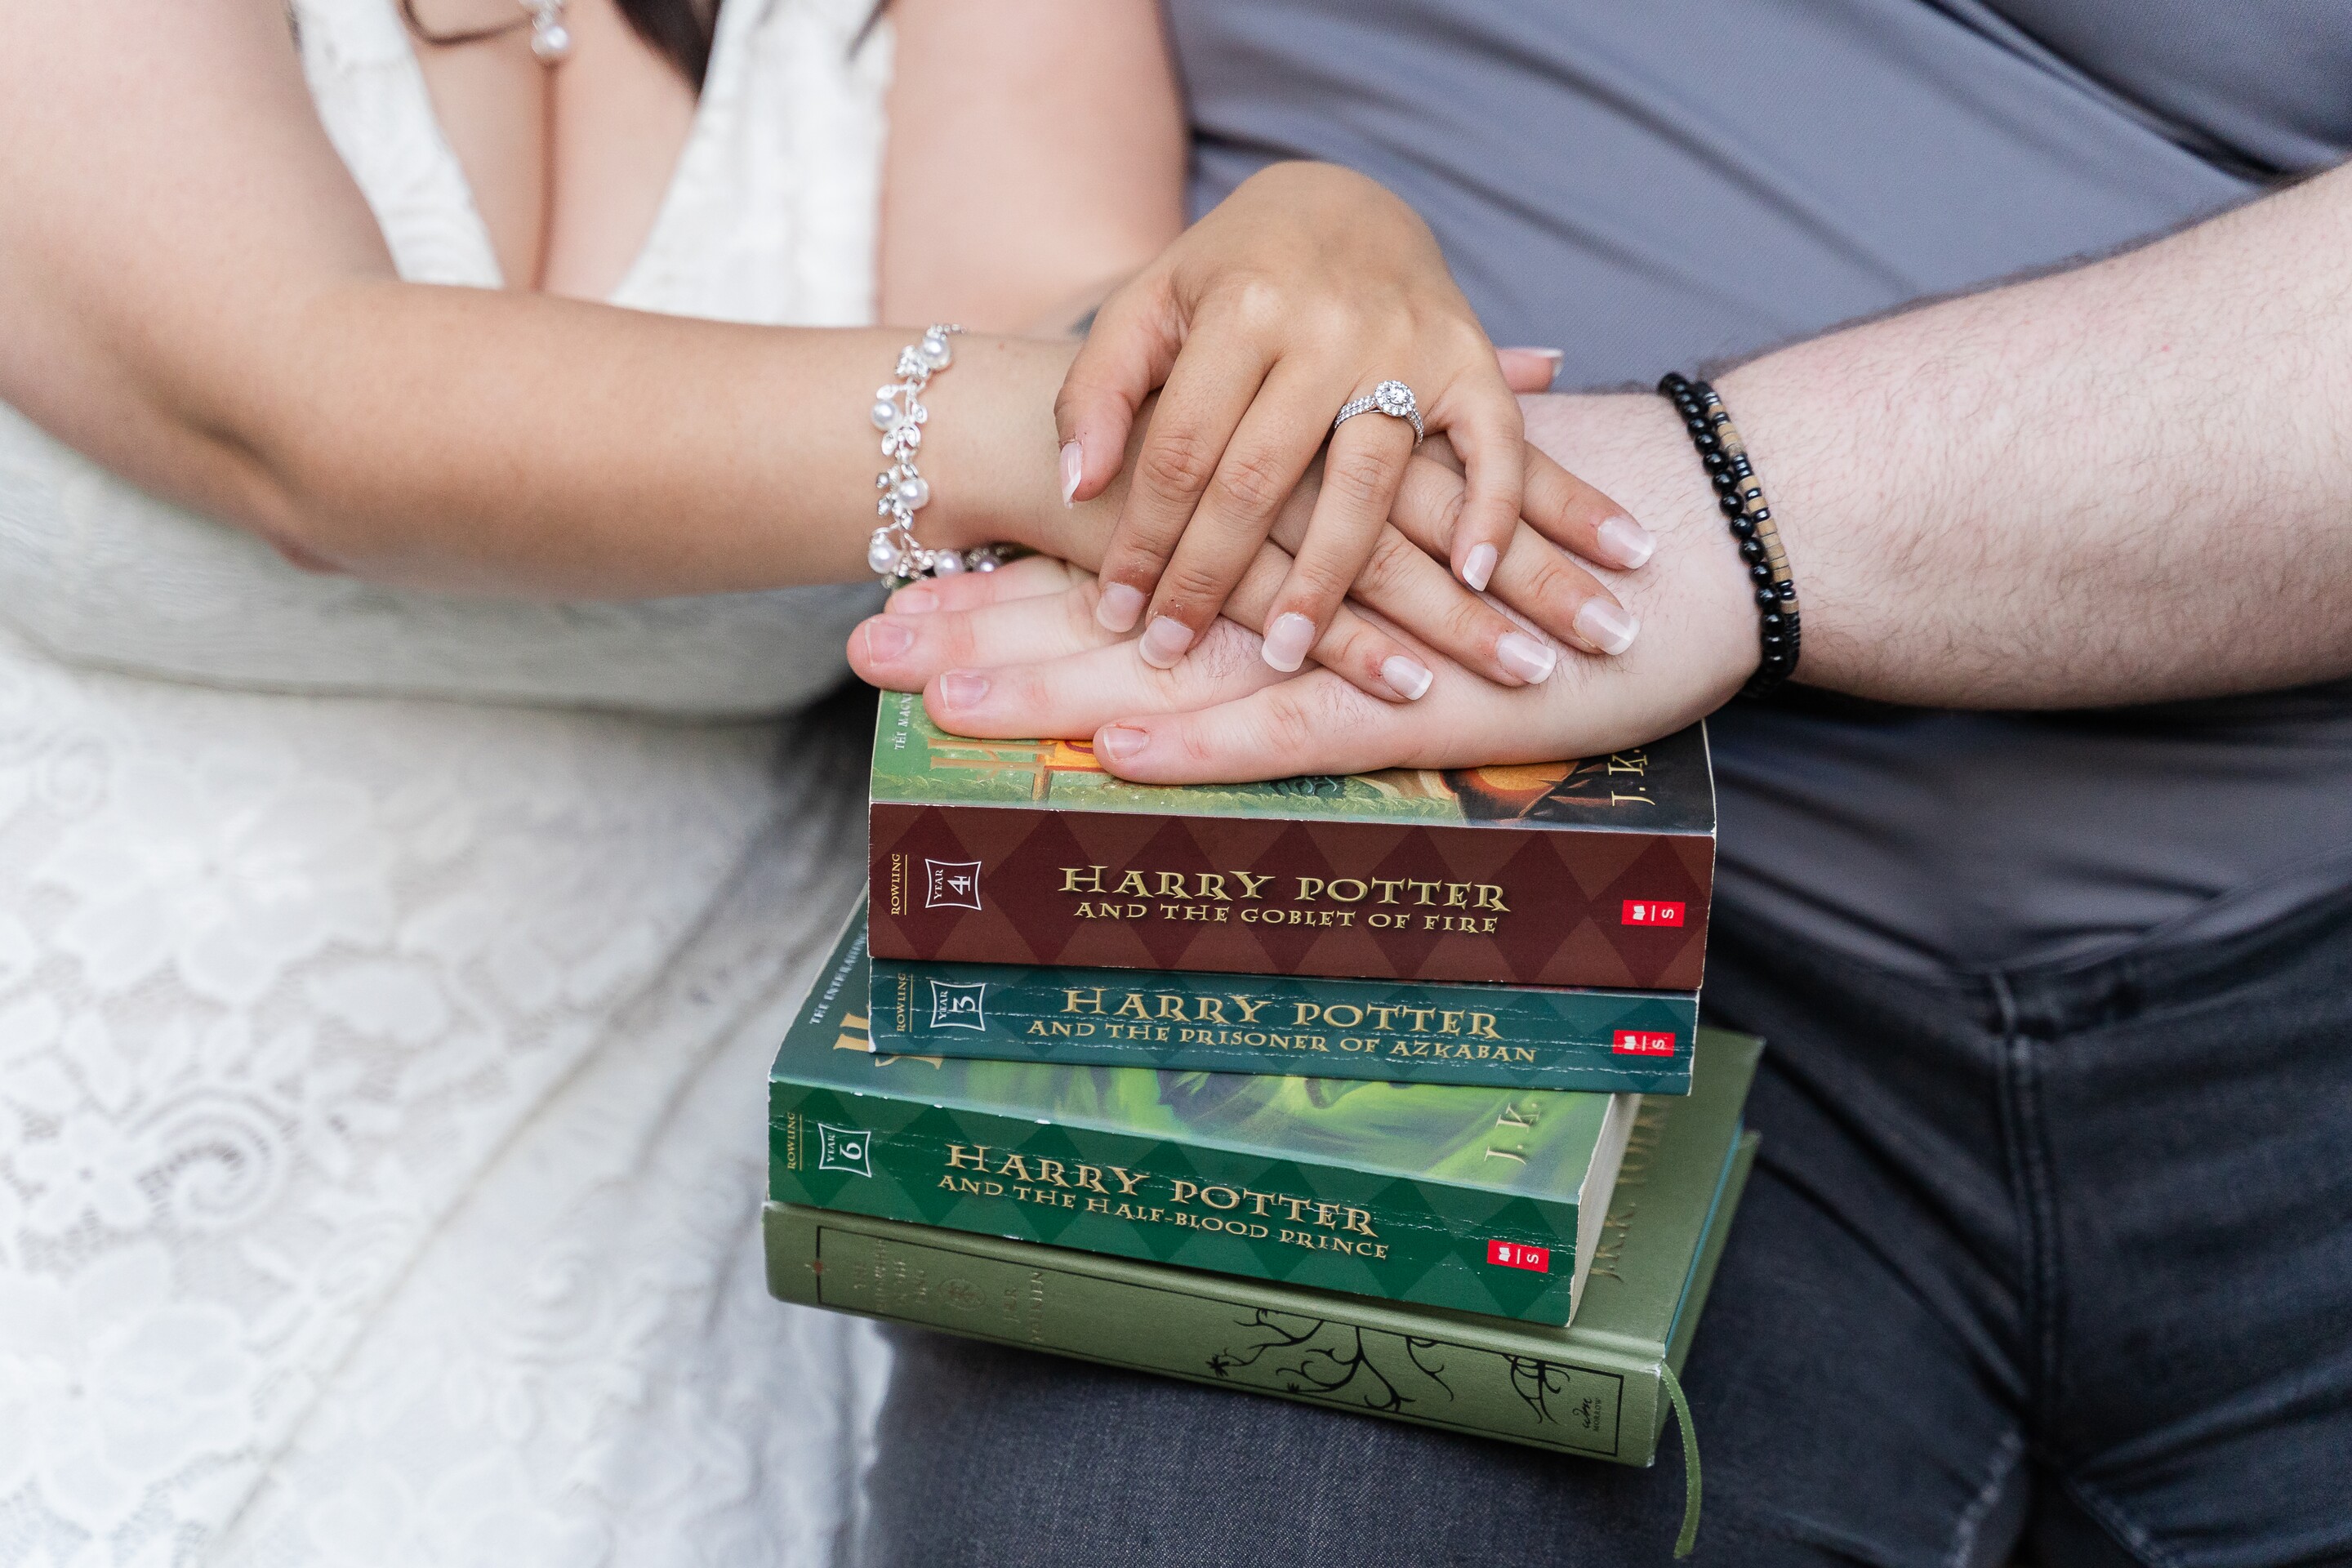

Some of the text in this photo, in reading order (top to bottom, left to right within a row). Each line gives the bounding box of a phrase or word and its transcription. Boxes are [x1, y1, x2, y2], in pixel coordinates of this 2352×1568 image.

[891, 853, 901, 915] ROWLING
[933, 869, 944, 900] YEAR
[947, 875, 971, 896] 4
[1057, 865, 1512, 912] HARRY POTTER
[1073, 902, 1499, 934] AND THE GOBLET OF FIRE
[896, 972, 907, 1033] ROWLING
[938, 991, 948, 1021] YEAR
[951, 995, 976, 1013] 3
[1059, 987, 1503, 1040] HARRY POTTER
[1027, 1019, 1538, 1063] AND THE PRISONER OF AZKABAN
[786, 1111, 797, 1169] ROWLING
[826, 1132, 836, 1163] YEAR
[840, 1142, 862, 1160] 6
[944, 1143, 1379, 1239] HARRY POTTER
[938, 1174, 1389, 1261] AND THE HALF-BLOOD PRINCE
[1593, 1397, 1601, 1432] MORROW
